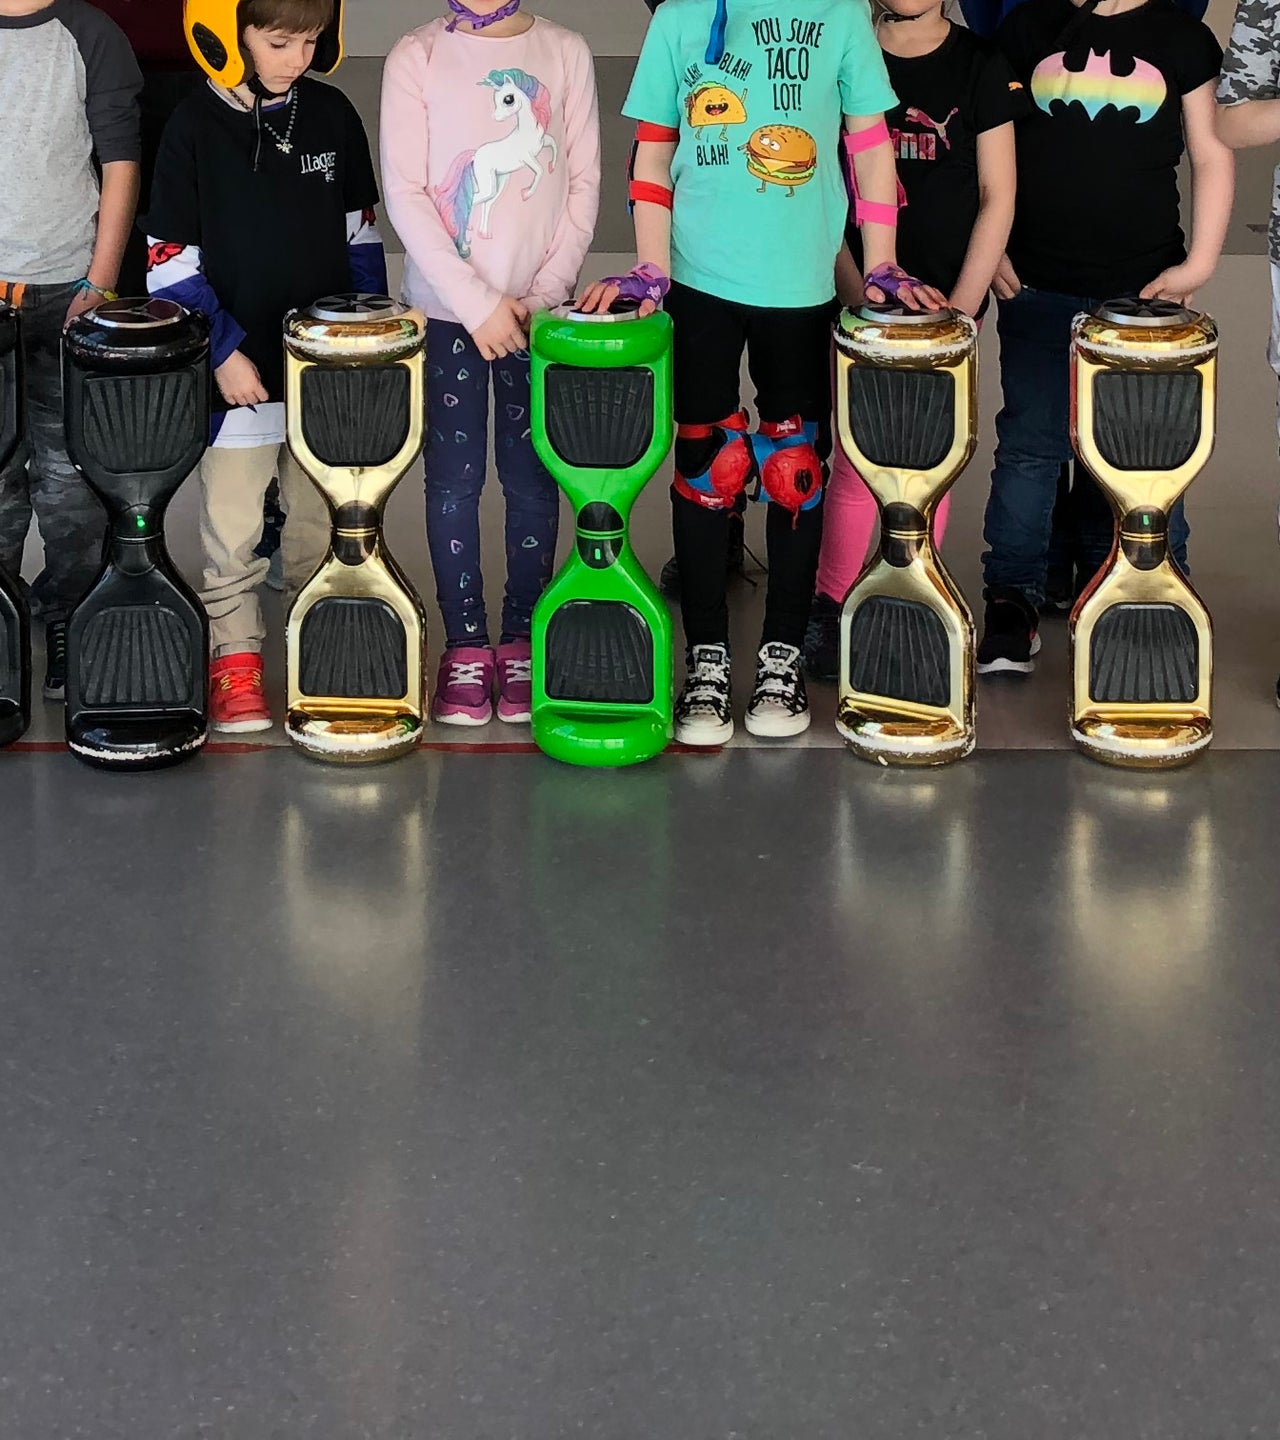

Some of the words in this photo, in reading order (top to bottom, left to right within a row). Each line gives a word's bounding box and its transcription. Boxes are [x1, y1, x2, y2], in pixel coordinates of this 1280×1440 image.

[751, 17, 782, 46] YOU
[786, 17, 825, 48] SURE
[718, 52, 753, 81] BLAH!
[764, 46, 810, 81] TACO
[772, 83, 802, 111] LOT!
[696, 144, 729, 166] BLAH!
